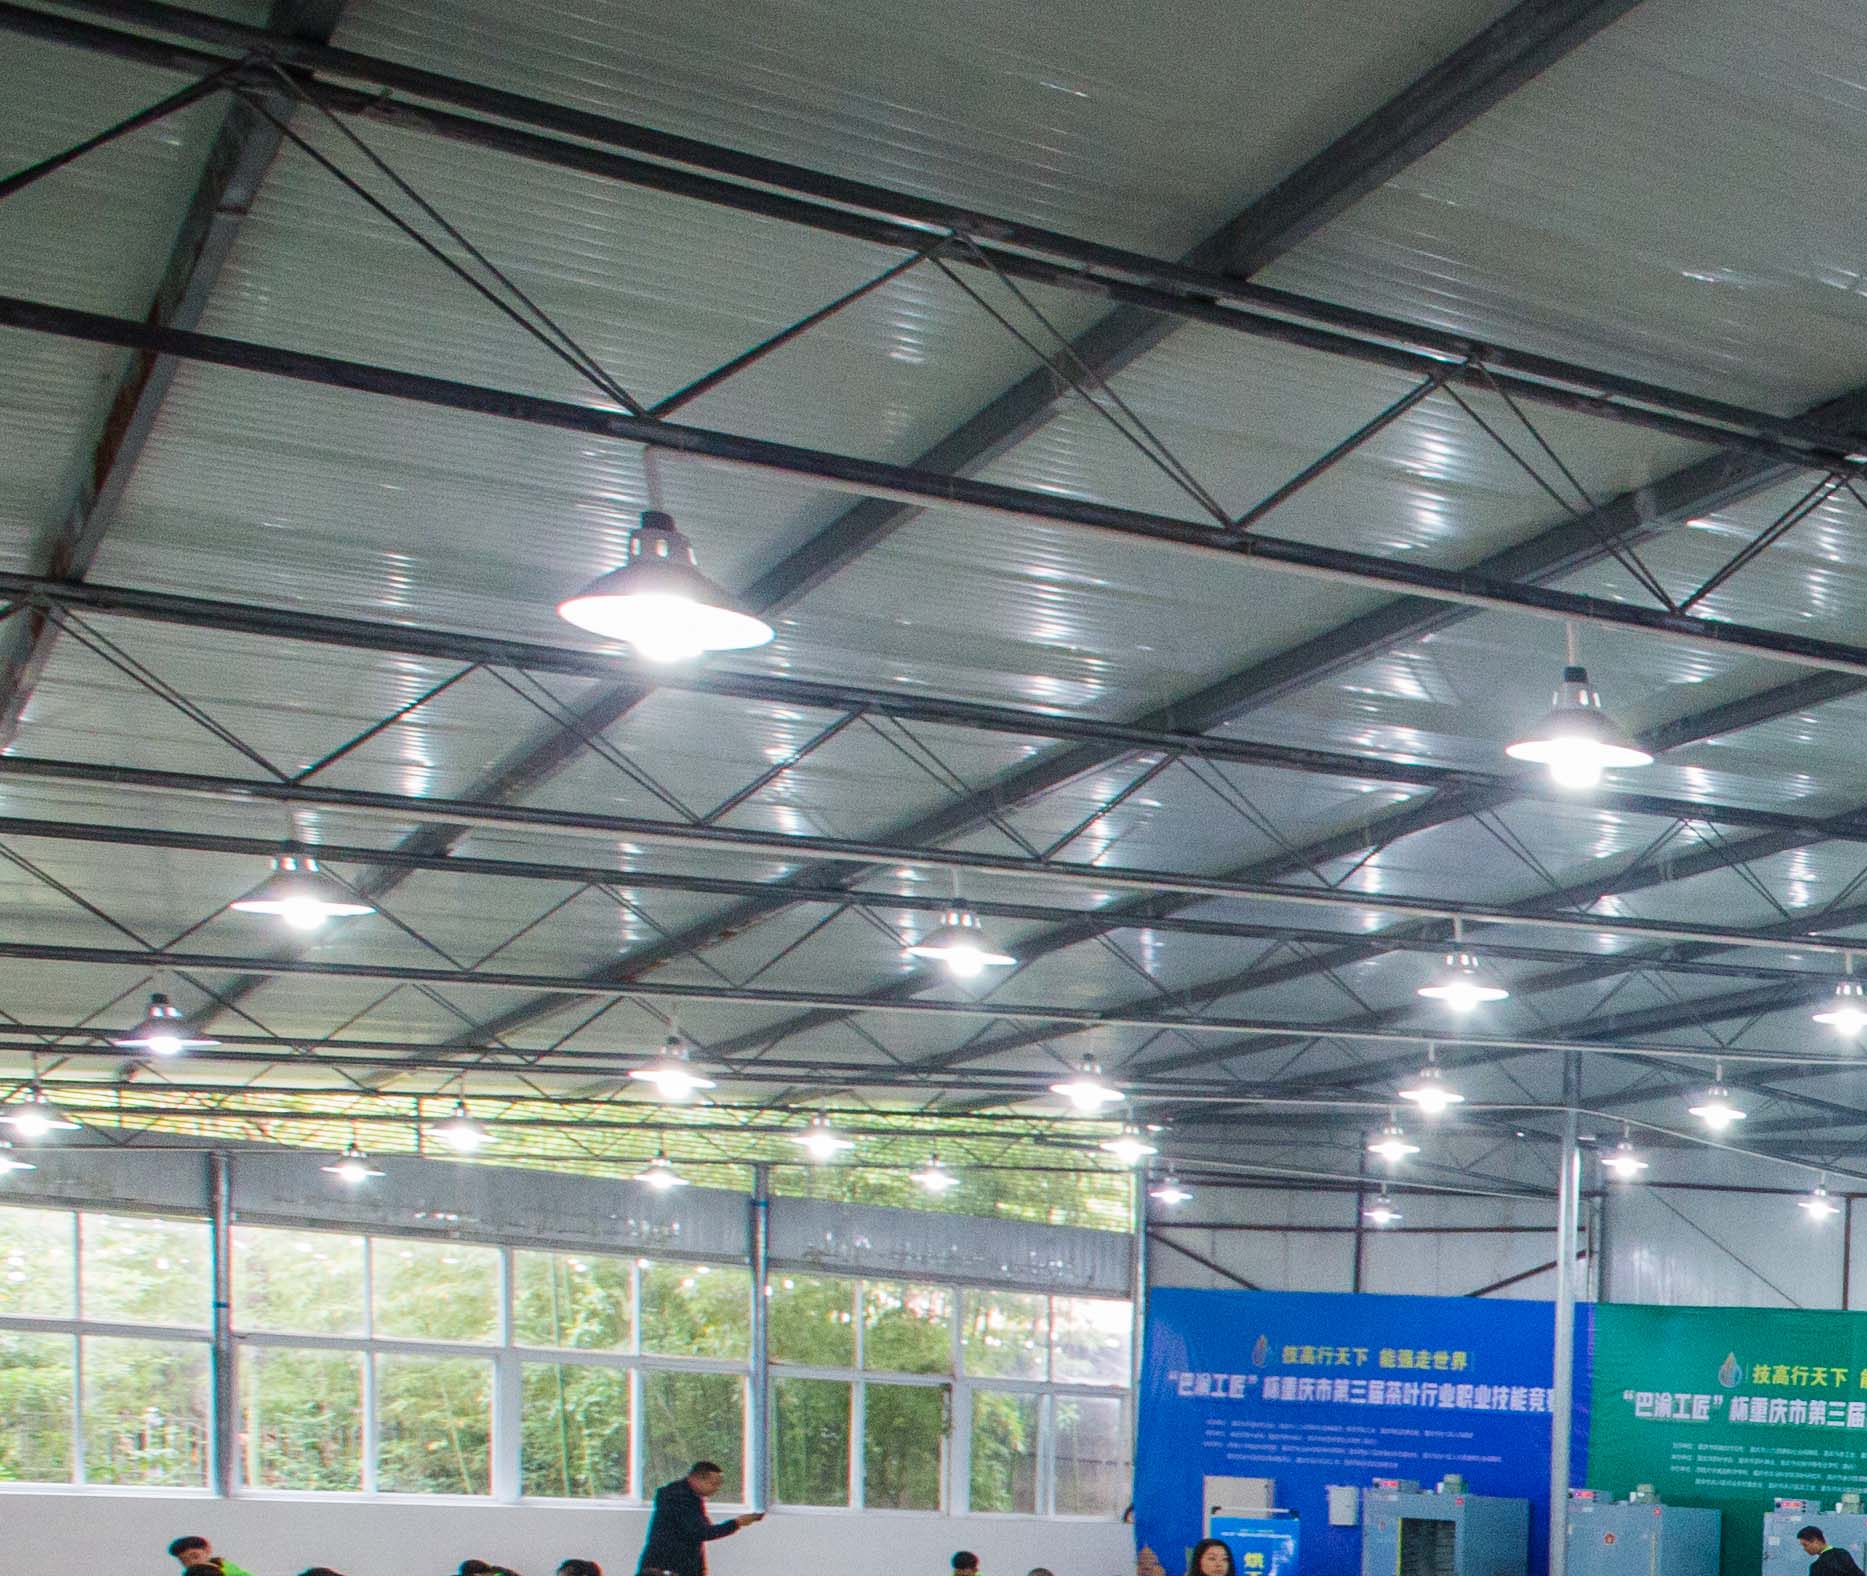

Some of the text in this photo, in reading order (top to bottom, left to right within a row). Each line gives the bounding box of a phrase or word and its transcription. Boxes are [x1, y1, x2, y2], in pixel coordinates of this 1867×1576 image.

[1752, 1363, 1849, 1388] 技高行天下
